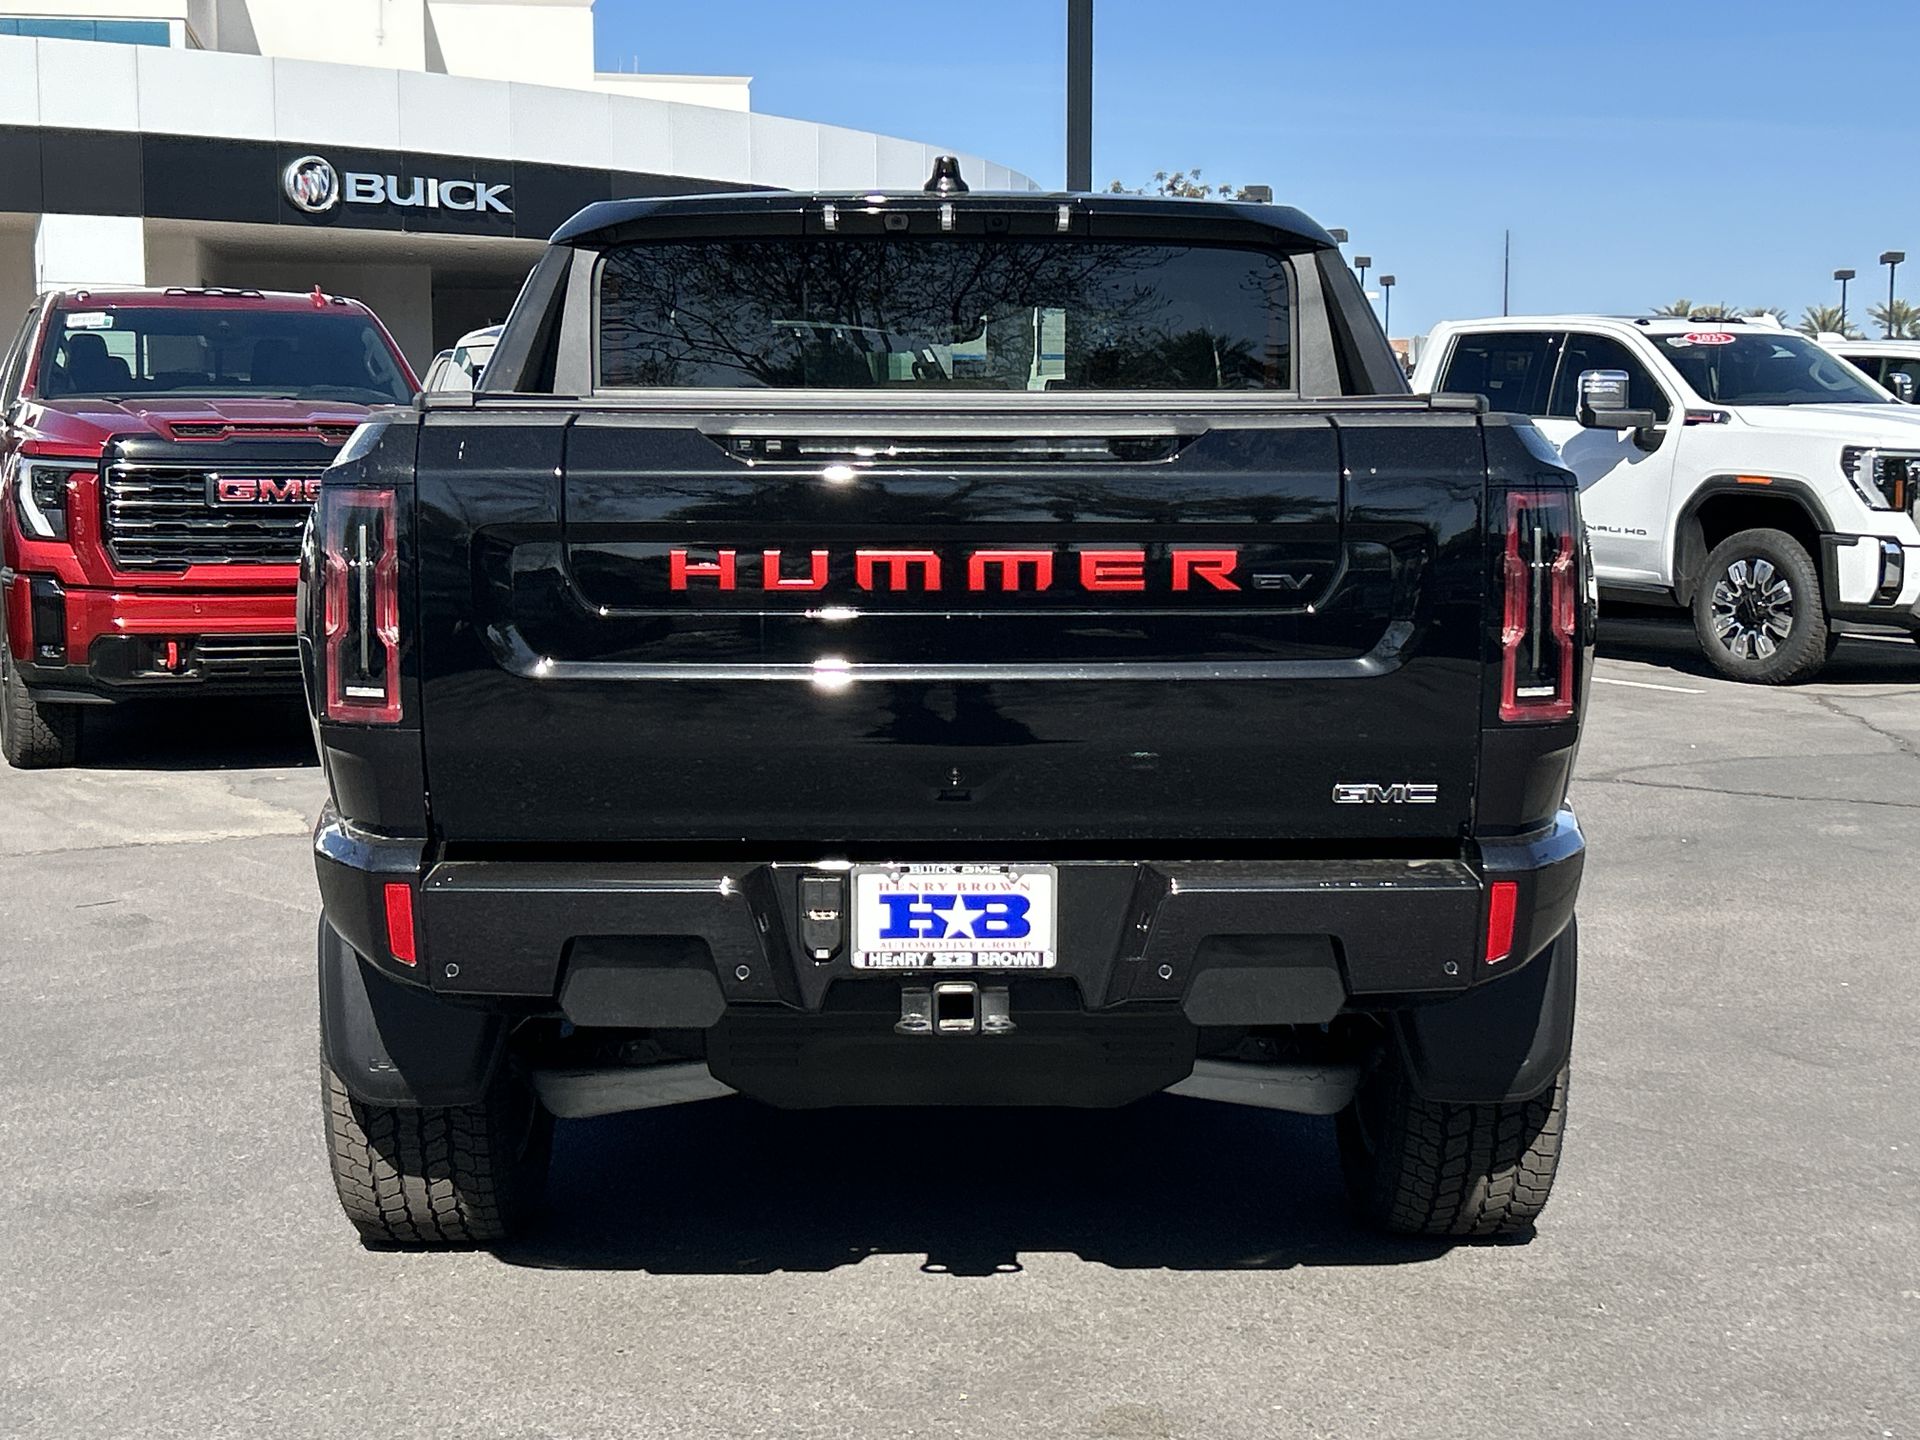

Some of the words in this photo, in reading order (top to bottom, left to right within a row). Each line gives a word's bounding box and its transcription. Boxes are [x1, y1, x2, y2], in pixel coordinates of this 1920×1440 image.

[345, 171, 514, 214] BUICK
[670, 549, 1242, 592] HUMMER
[1252, 573, 1313, 590] EV
[1332, 783, 1438, 804] GMC
[909, 865, 957, 874] BUICK
[962, 865, 1001, 874] GMC
[879, 882, 948, 892] HENRY
[957, 882, 1031, 892] BROWN
[880, 941, 977, 950] AUTOMOTIVE
[982, 941, 1031, 950] GROUP
[868, 952, 927, 967] HENRY
[978, 952, 1040, 967] BROWN
